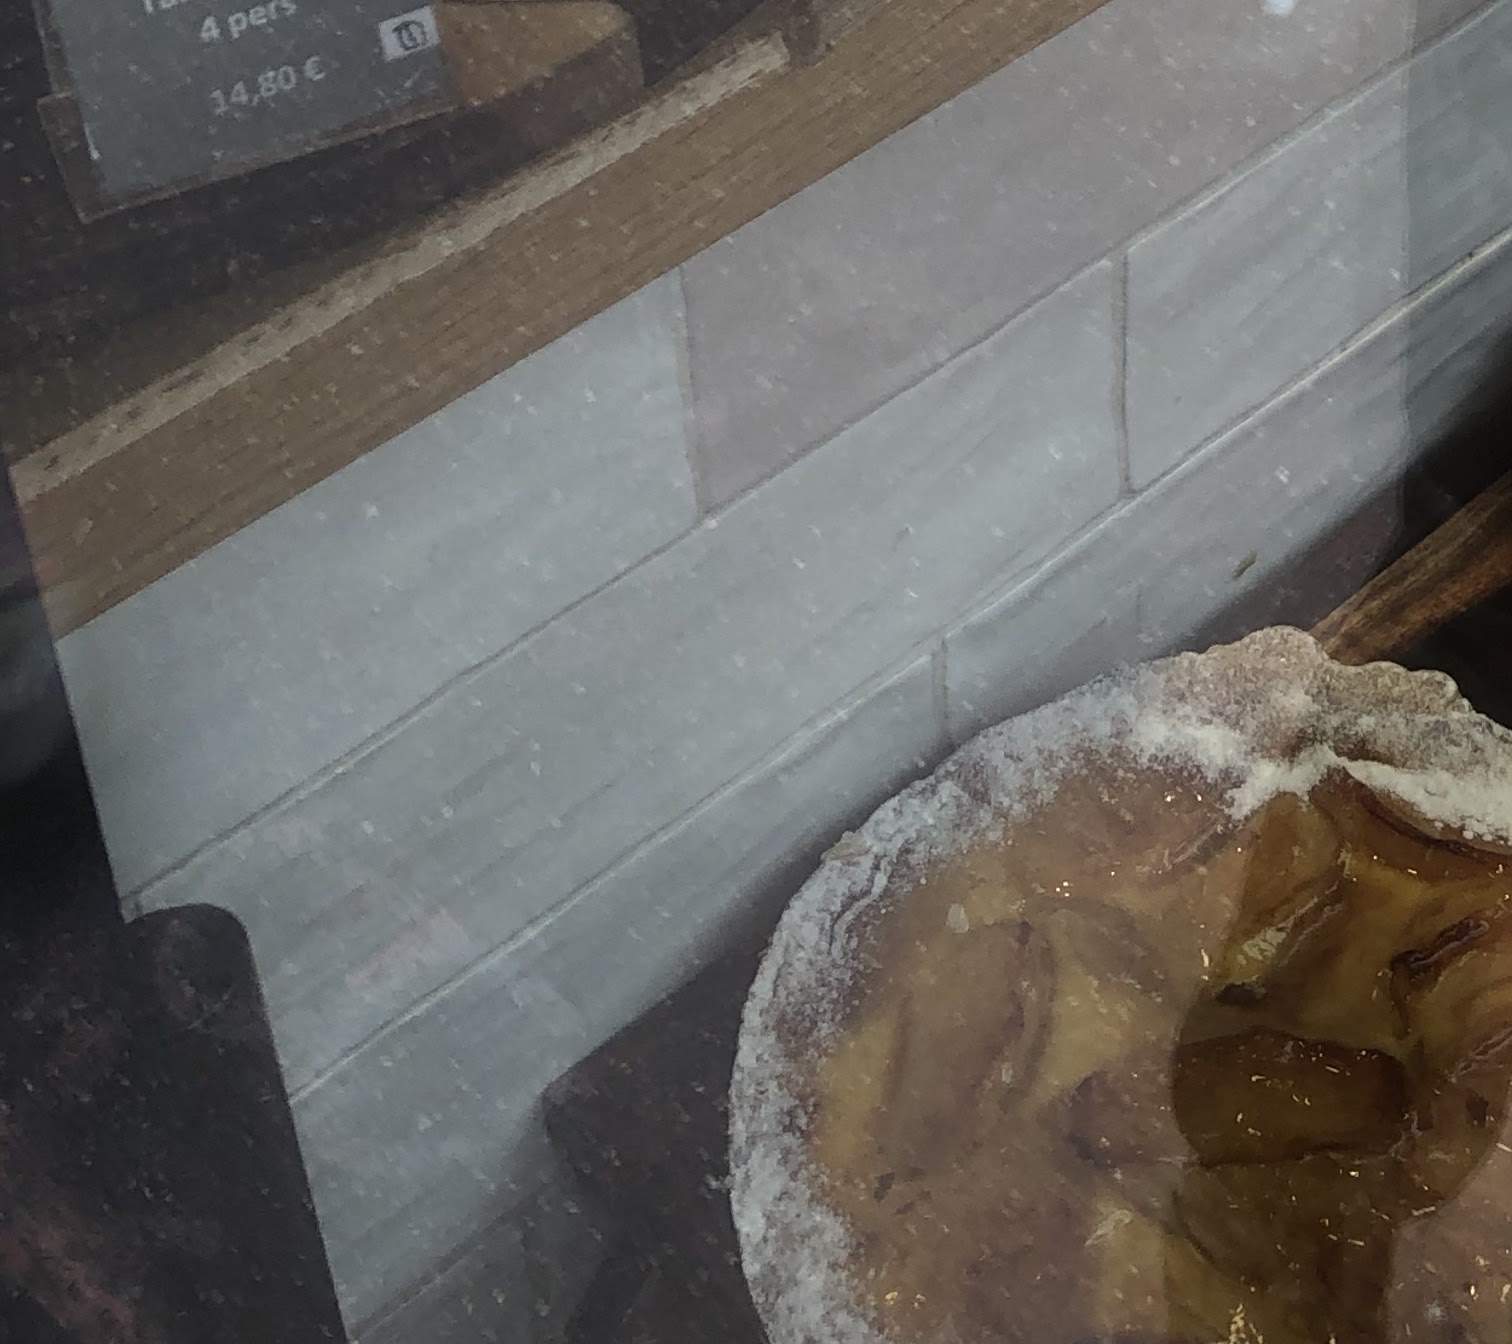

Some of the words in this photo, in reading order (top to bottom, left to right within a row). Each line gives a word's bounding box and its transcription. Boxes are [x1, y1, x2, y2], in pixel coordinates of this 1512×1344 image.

[199, 16, 220, 43] 4
[209, 63, 298, 116] 14,80
[301, 54, 326, 83] €
